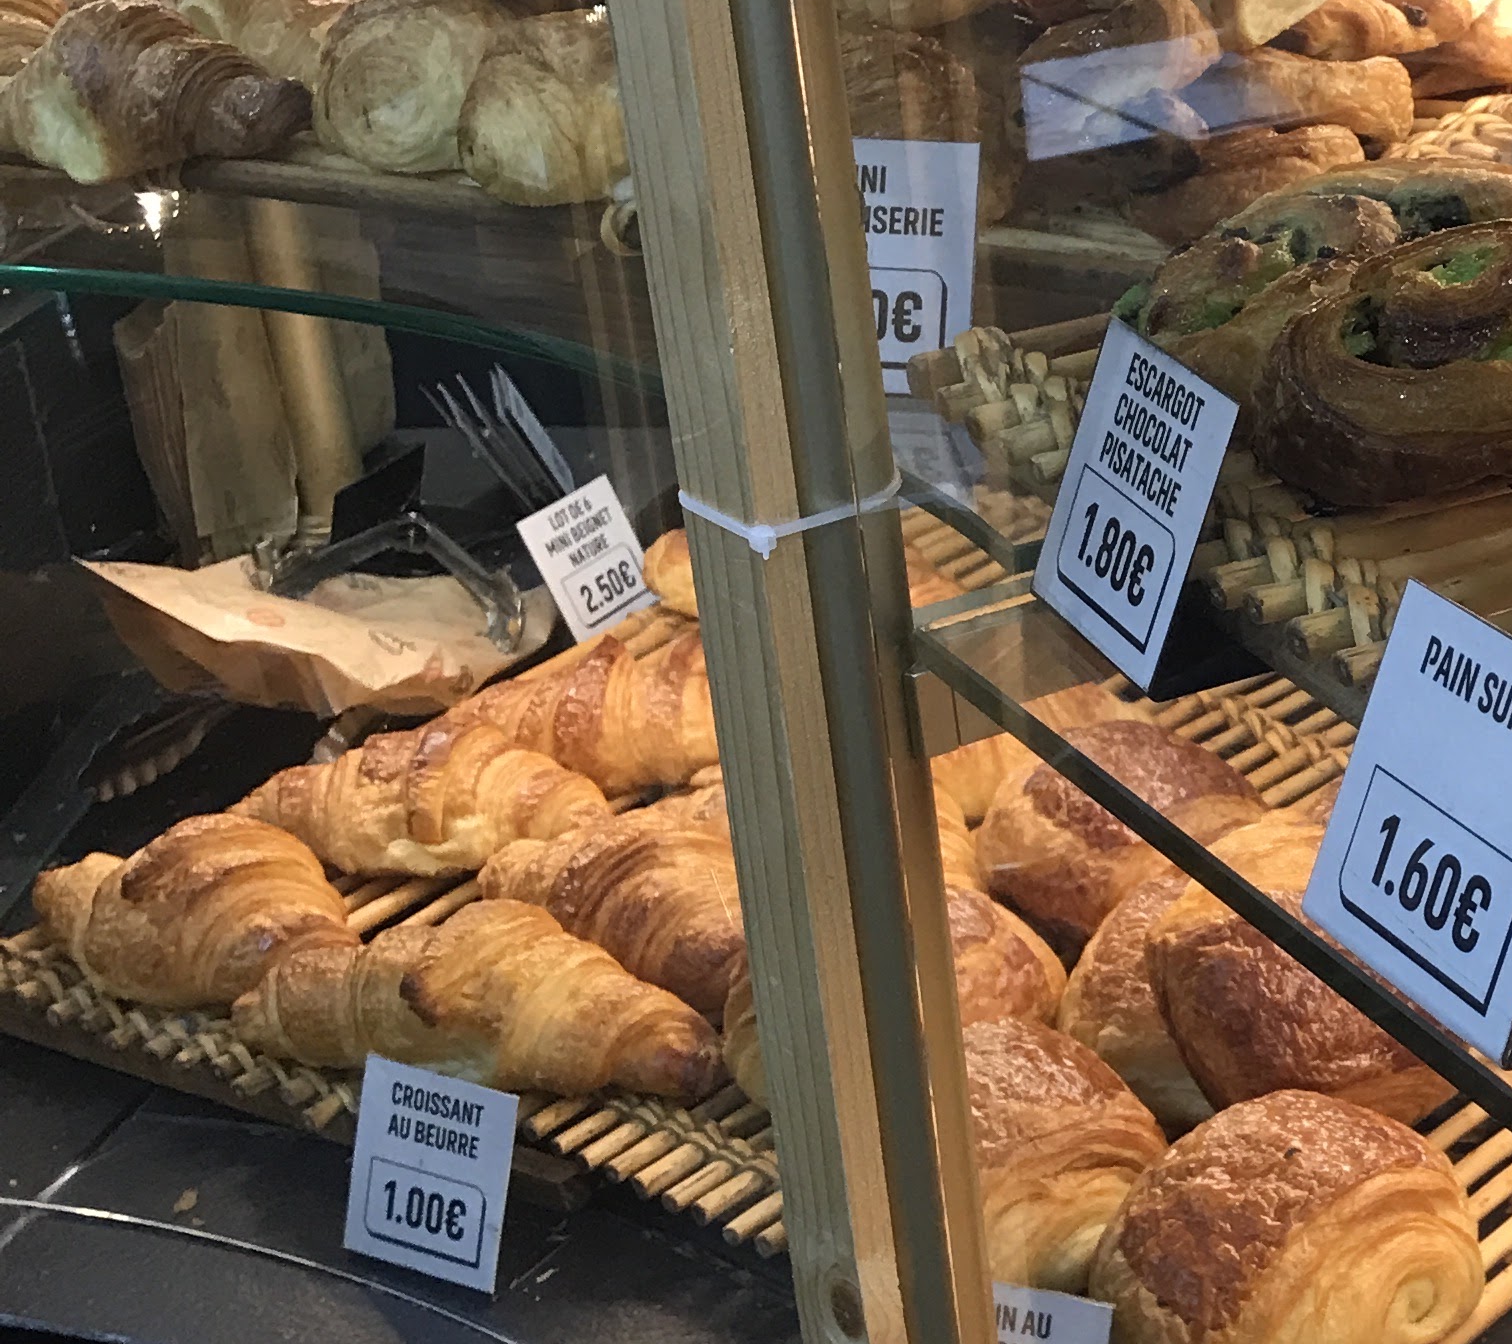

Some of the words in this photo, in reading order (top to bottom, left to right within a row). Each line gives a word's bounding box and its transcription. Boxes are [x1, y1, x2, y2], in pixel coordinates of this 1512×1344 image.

[1126, 352, 1205, 431] ESCARGOT
[1114, 393, 1192, 473] CHOCOLAT
[1100, 430, 1181, 518] PISATACHE
[545, 531, 573, 558] MINI
[570, 506, 613, 543] BEIGNET
[548, 506, 570, 531] LOT
[568, 499, 584, 519] DE
[568, 533, 610, 567] NATURE
[1077, 502, 1155, 607] 1.80€
[580, 560, 637, 613] 2.50€
[1419, 635, 1481, 703] PAIN
[1371, 814, 1493, 954] 1.60€
[391, 1081, 485, 1128] CROISSANT
[387, 1114, 411, 1140] AU
[414, 1121, 481, 1161] BEURRE
[383, 1179, 467, 1242] 1.00€
[1021, 1310, 1052, 1339] AU
